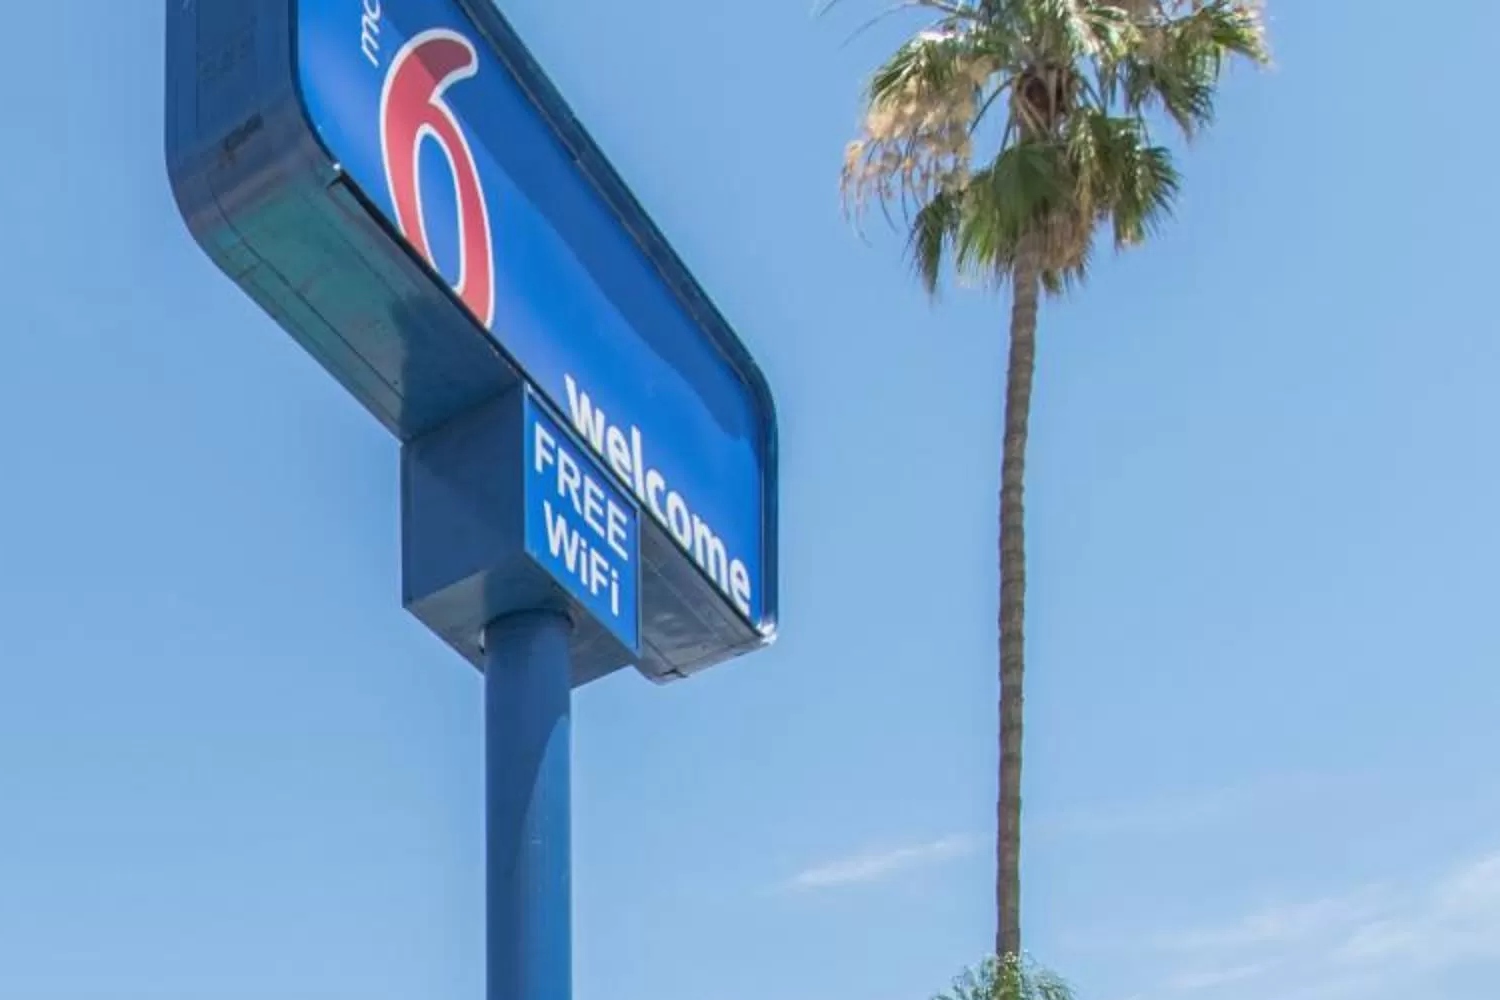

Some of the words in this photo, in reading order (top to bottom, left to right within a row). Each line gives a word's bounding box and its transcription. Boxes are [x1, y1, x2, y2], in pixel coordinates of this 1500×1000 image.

[379, 28, 495, 331] 6
[534, 421, 629, 561] FREE
[543, 499, 620, 617] WiFi
